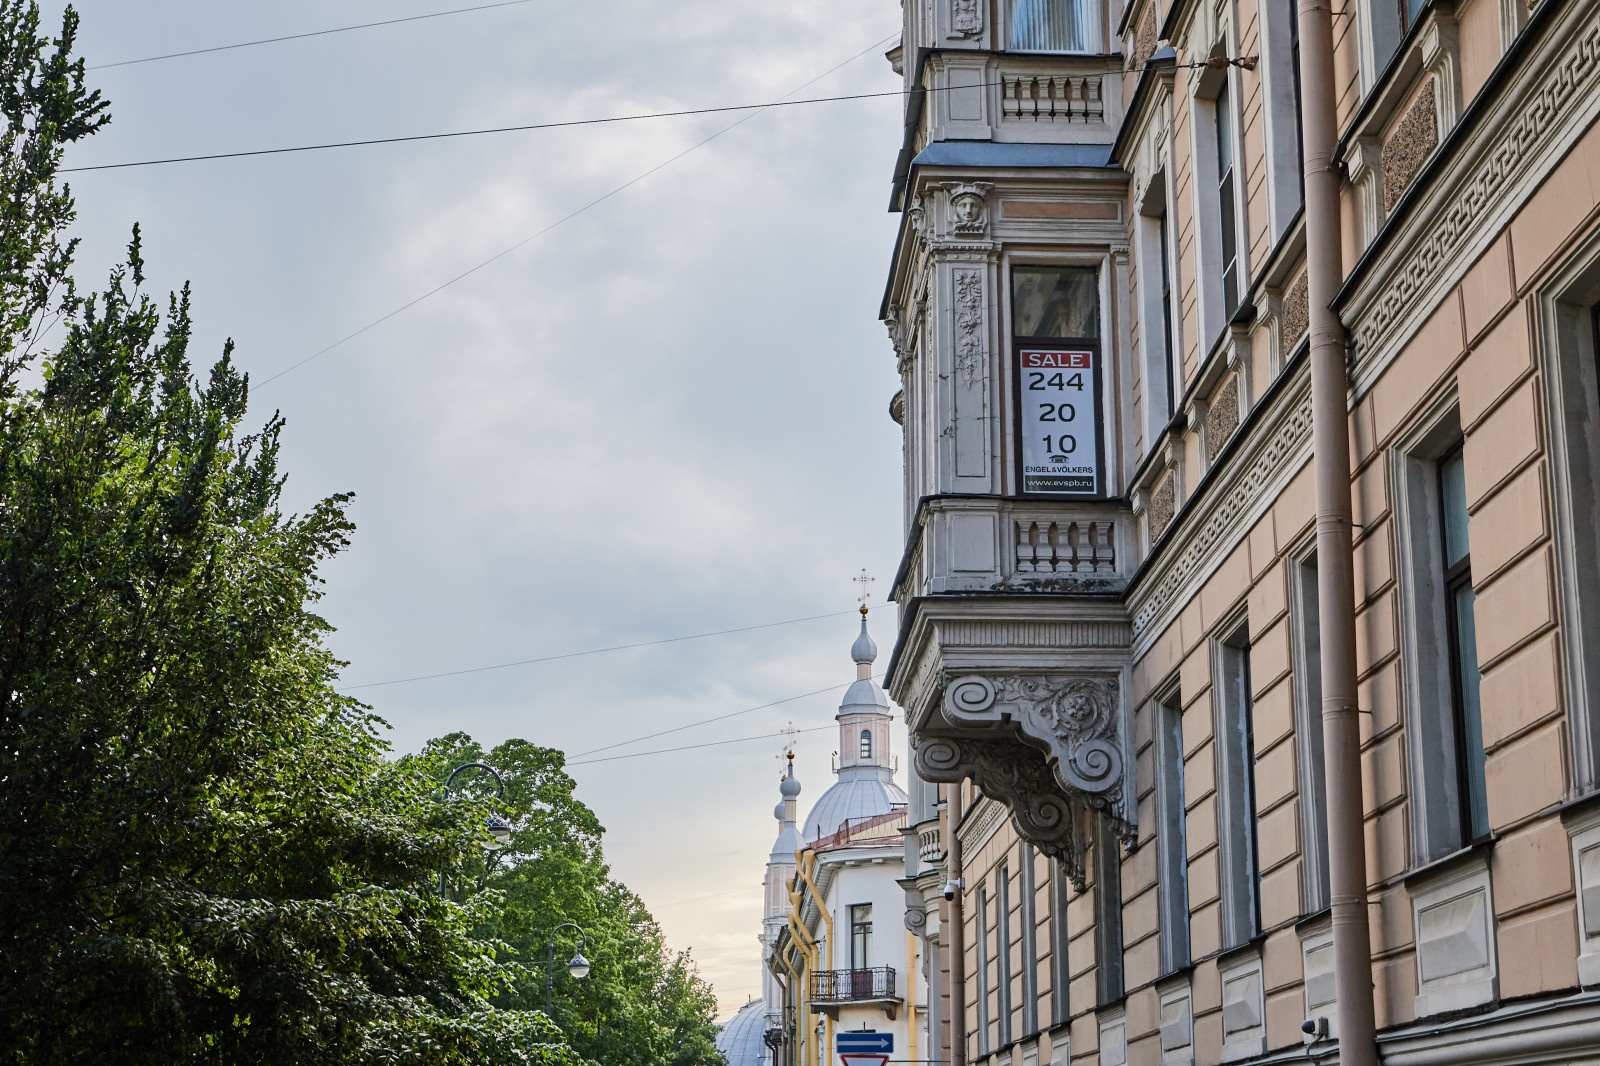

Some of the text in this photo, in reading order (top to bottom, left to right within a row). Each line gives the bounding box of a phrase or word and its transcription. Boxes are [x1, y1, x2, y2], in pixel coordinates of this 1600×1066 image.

[1029, 354, 1083, 367] SALE
[1029, 372, 1084, 391] 244
[1039, 403, 1075, 422] 20
[1042, 434, 1076, 453] 10
